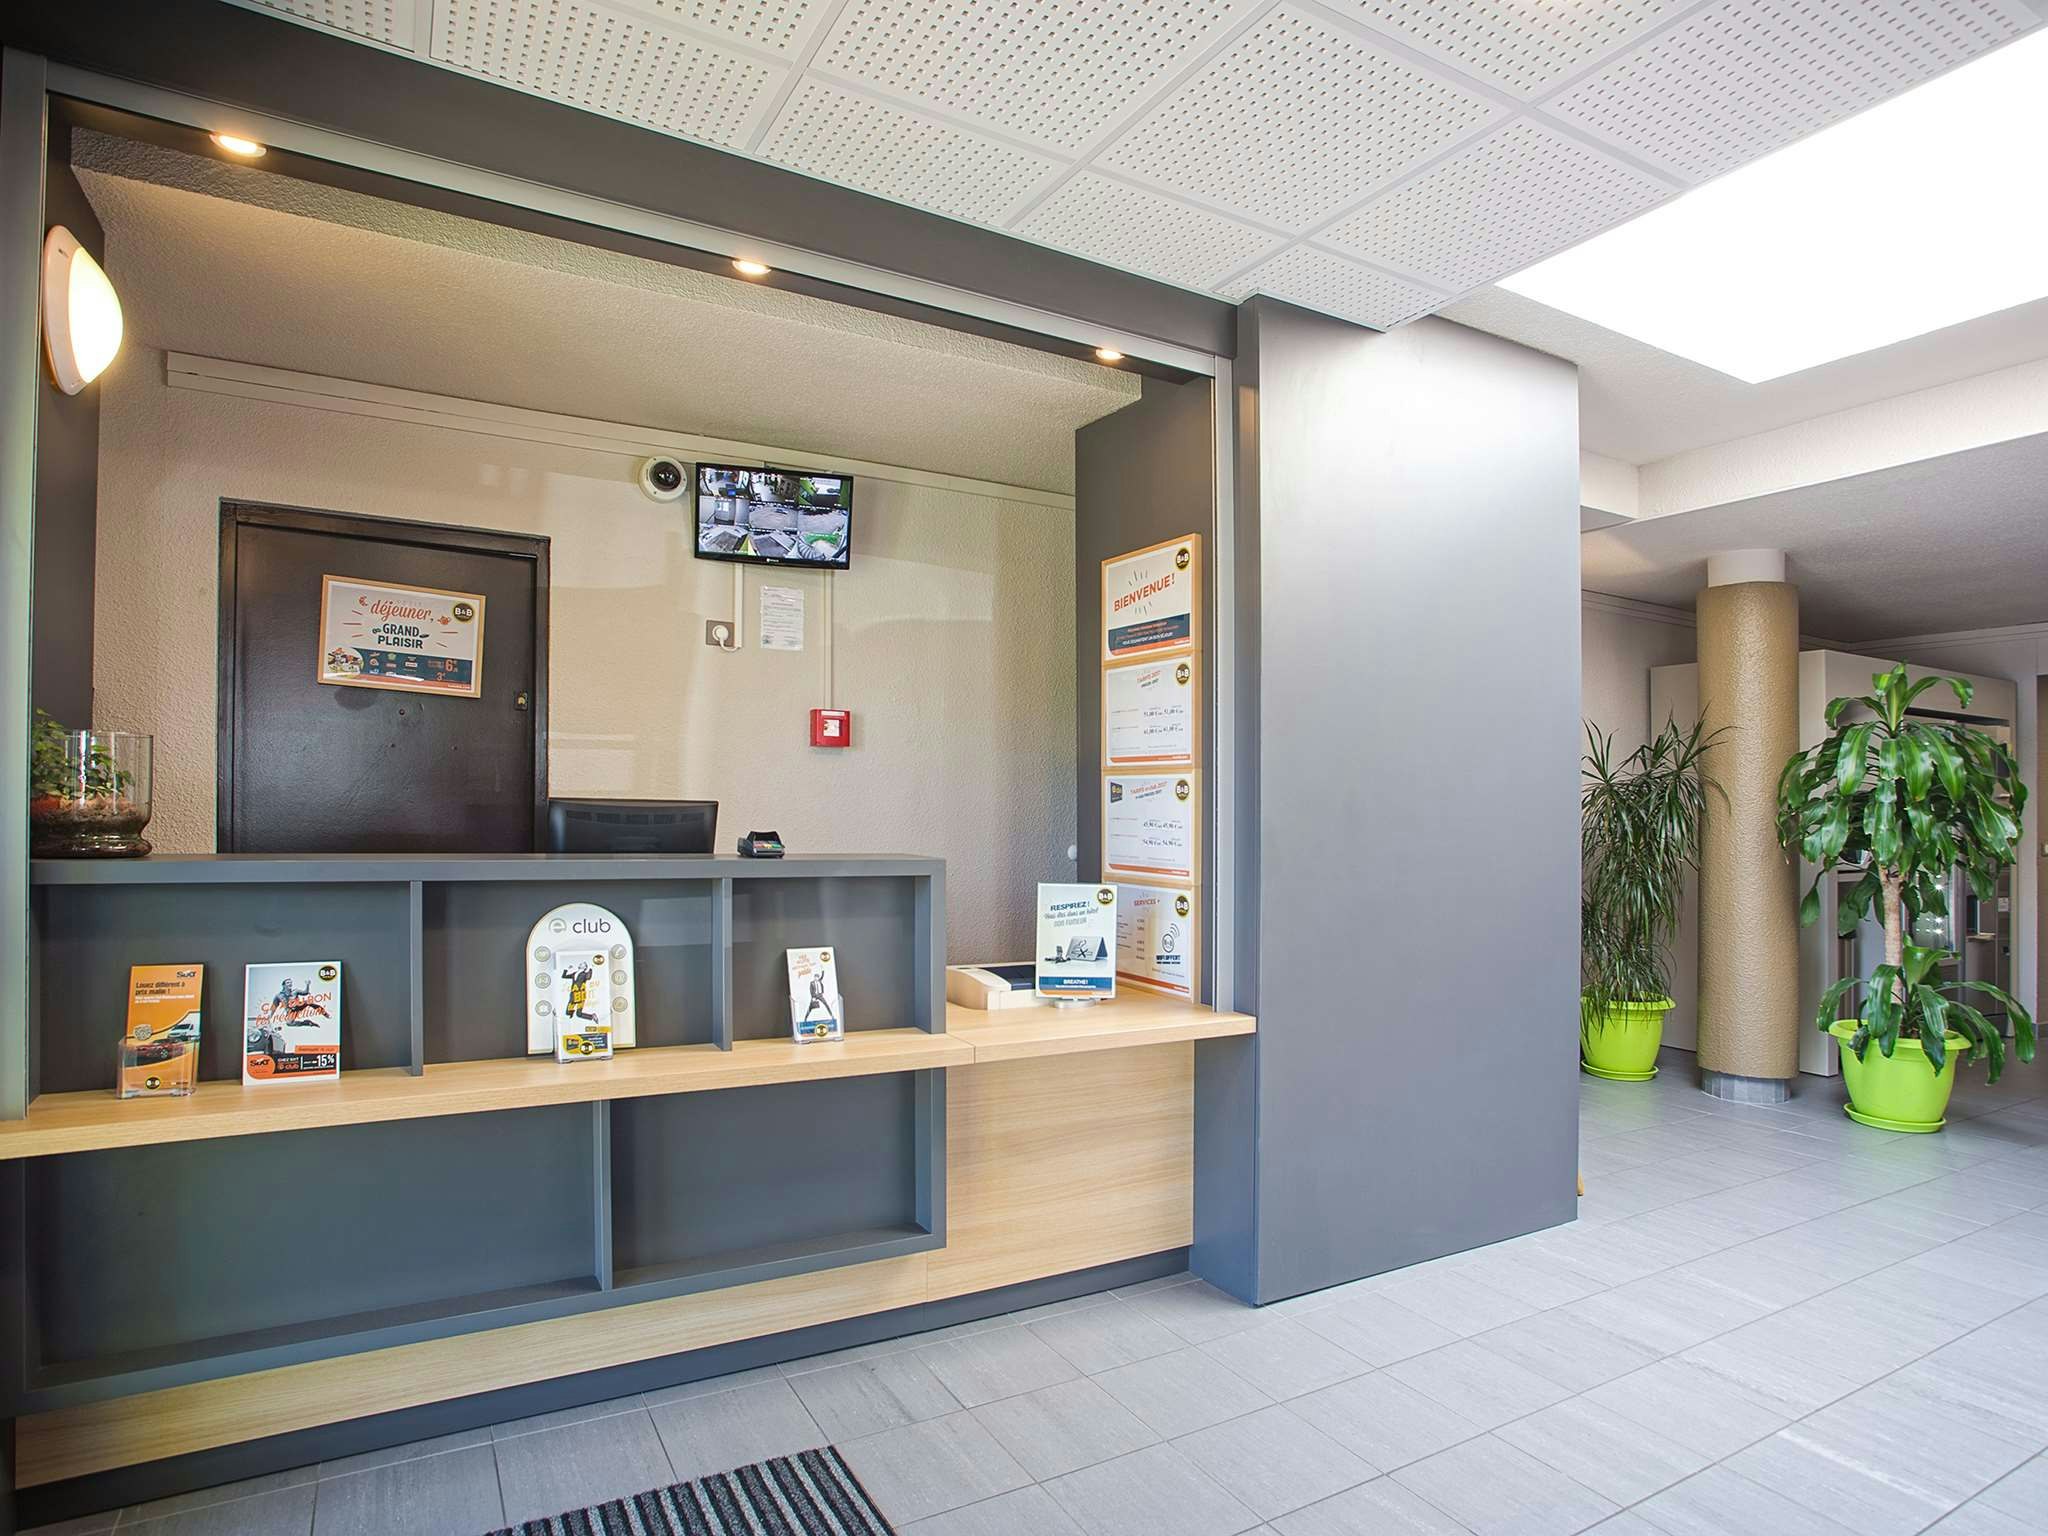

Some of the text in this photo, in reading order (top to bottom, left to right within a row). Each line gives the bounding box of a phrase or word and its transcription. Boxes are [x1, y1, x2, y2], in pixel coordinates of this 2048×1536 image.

[454, 607, 473, 617] B&B
[382, 623, 420, 637] GRAND
[377, 635, 423, 649] PLAISIR
[572, 918, 611, 934] club
